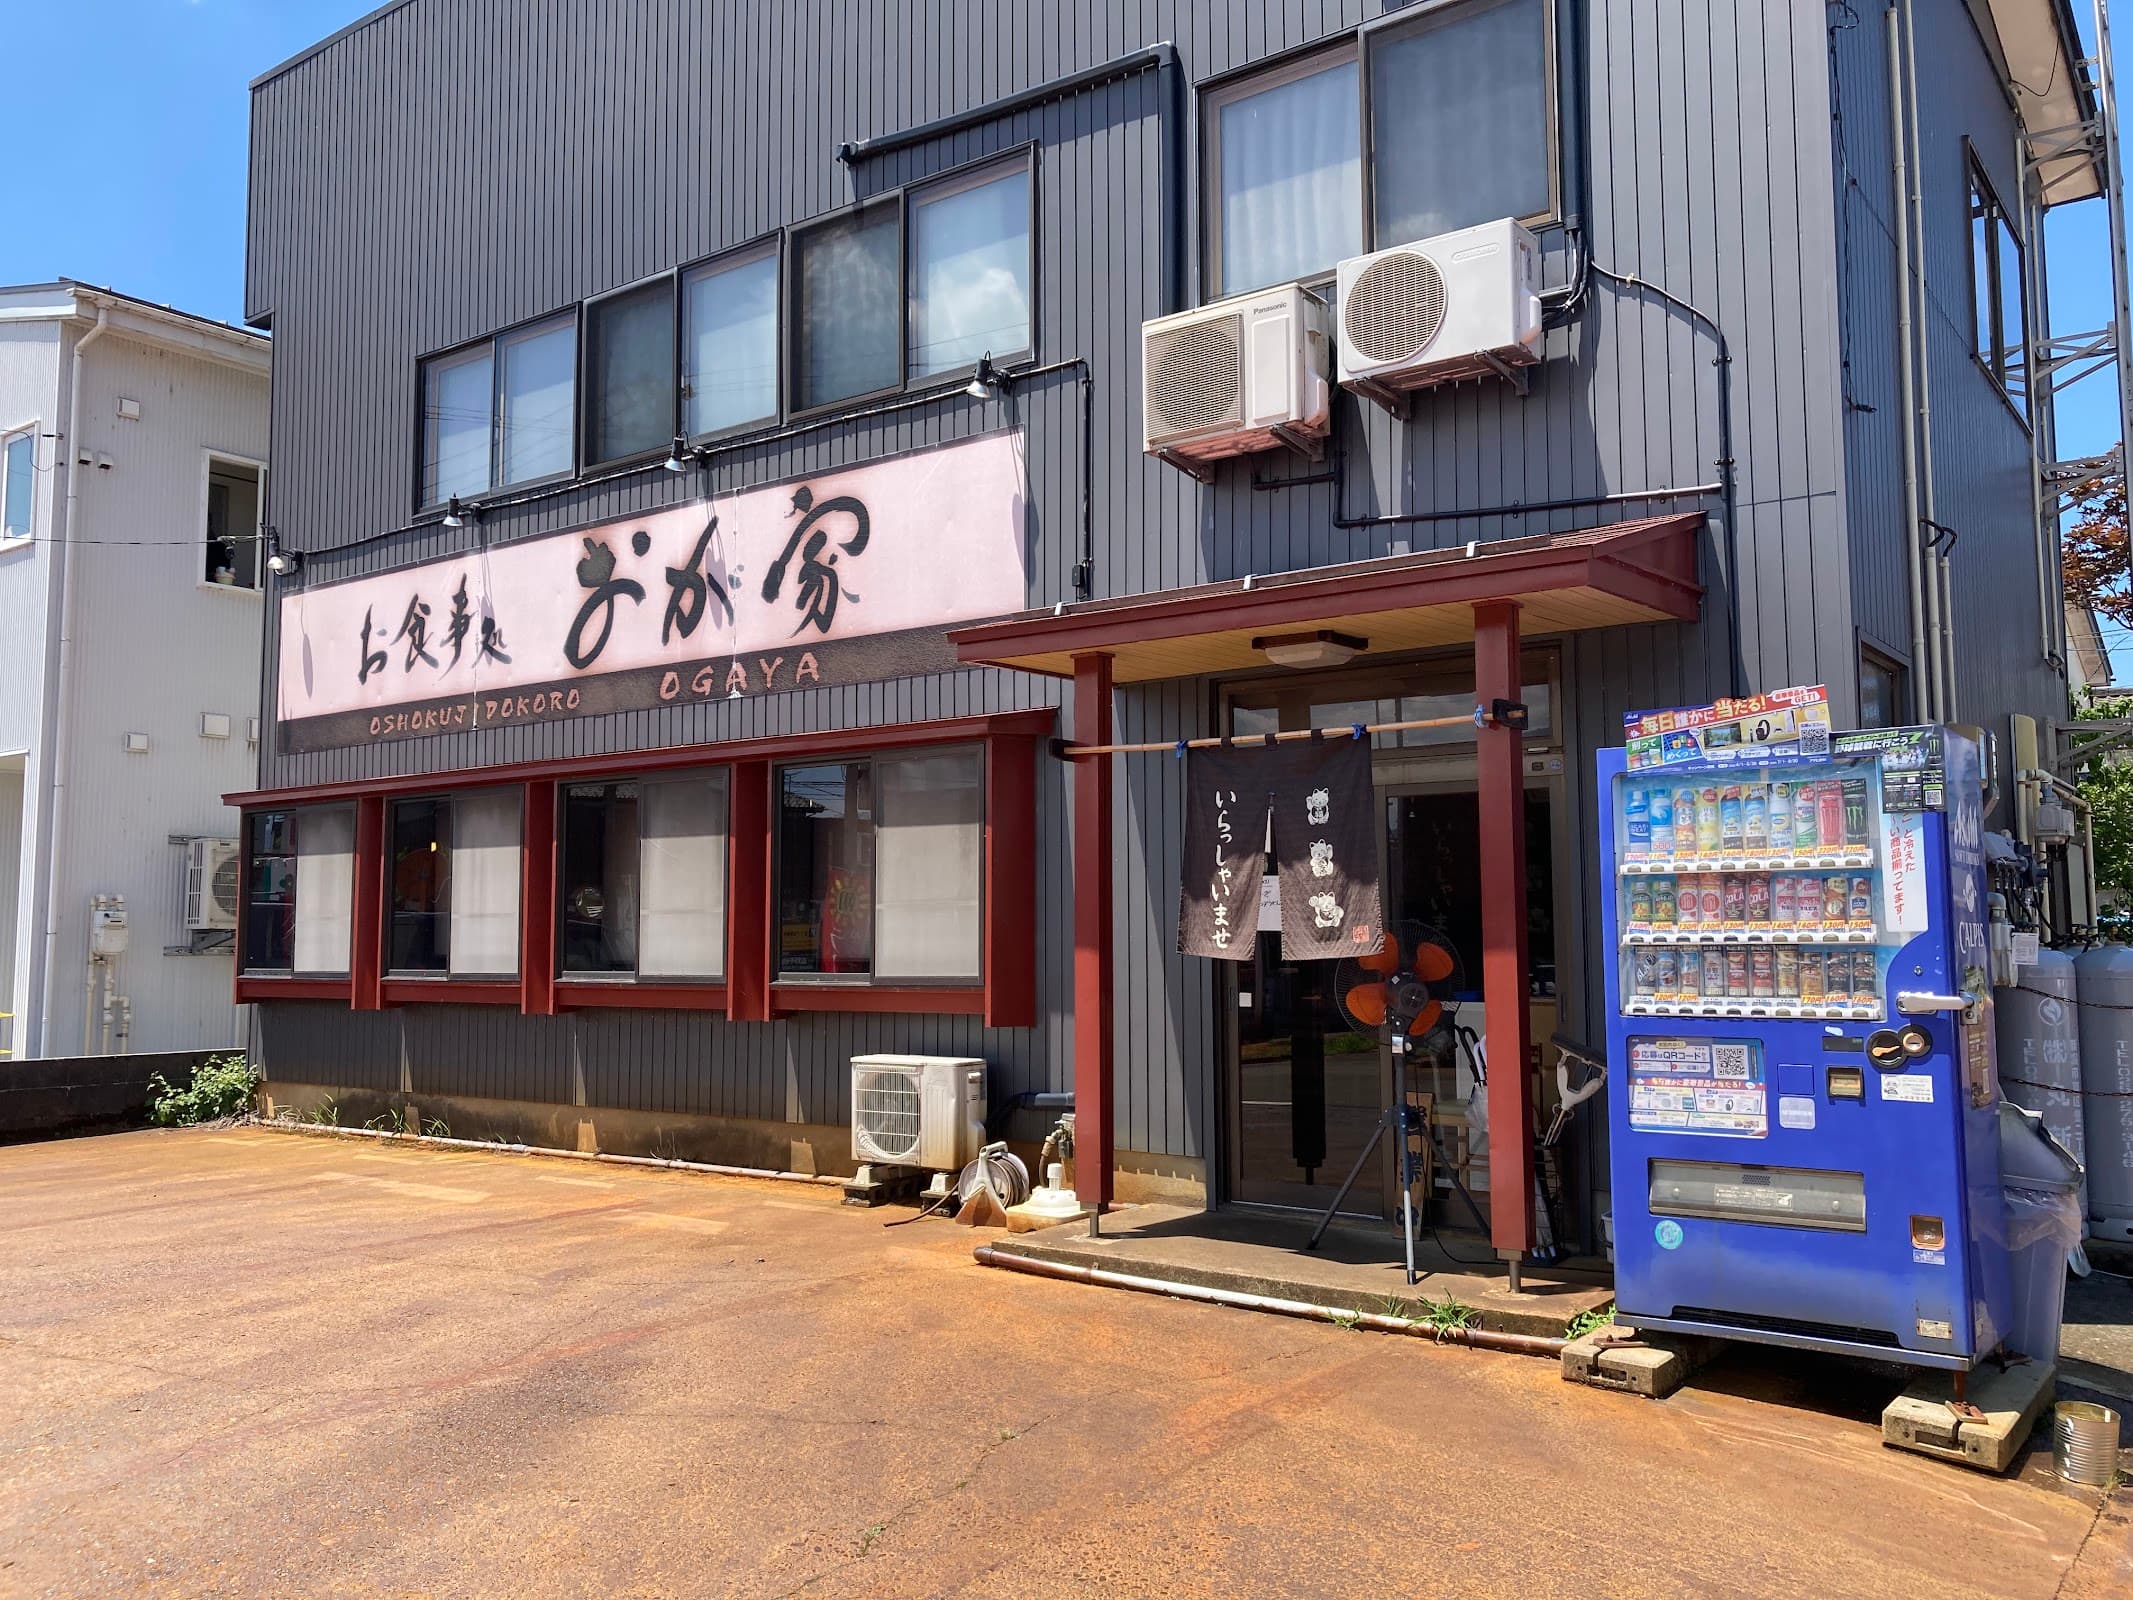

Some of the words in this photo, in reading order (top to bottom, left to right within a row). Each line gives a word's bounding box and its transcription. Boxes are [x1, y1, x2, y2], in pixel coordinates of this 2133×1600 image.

[1253, 301, 1287, 315] Panasonic
[358, 572, 513, 685] お食事処
[660, 650, 821, 700] OGAYA
[484, 688, 581, 721] DOKORO
[1665, 748, 1697, 760] めくって
[1211, 790, 1237, 949] いらっしゃいませ
[1724, 891, 1745, 906] COLA
[1749, 891, 1769, 905] COLA
[1958, 921, 1985, 955] CALPIS
